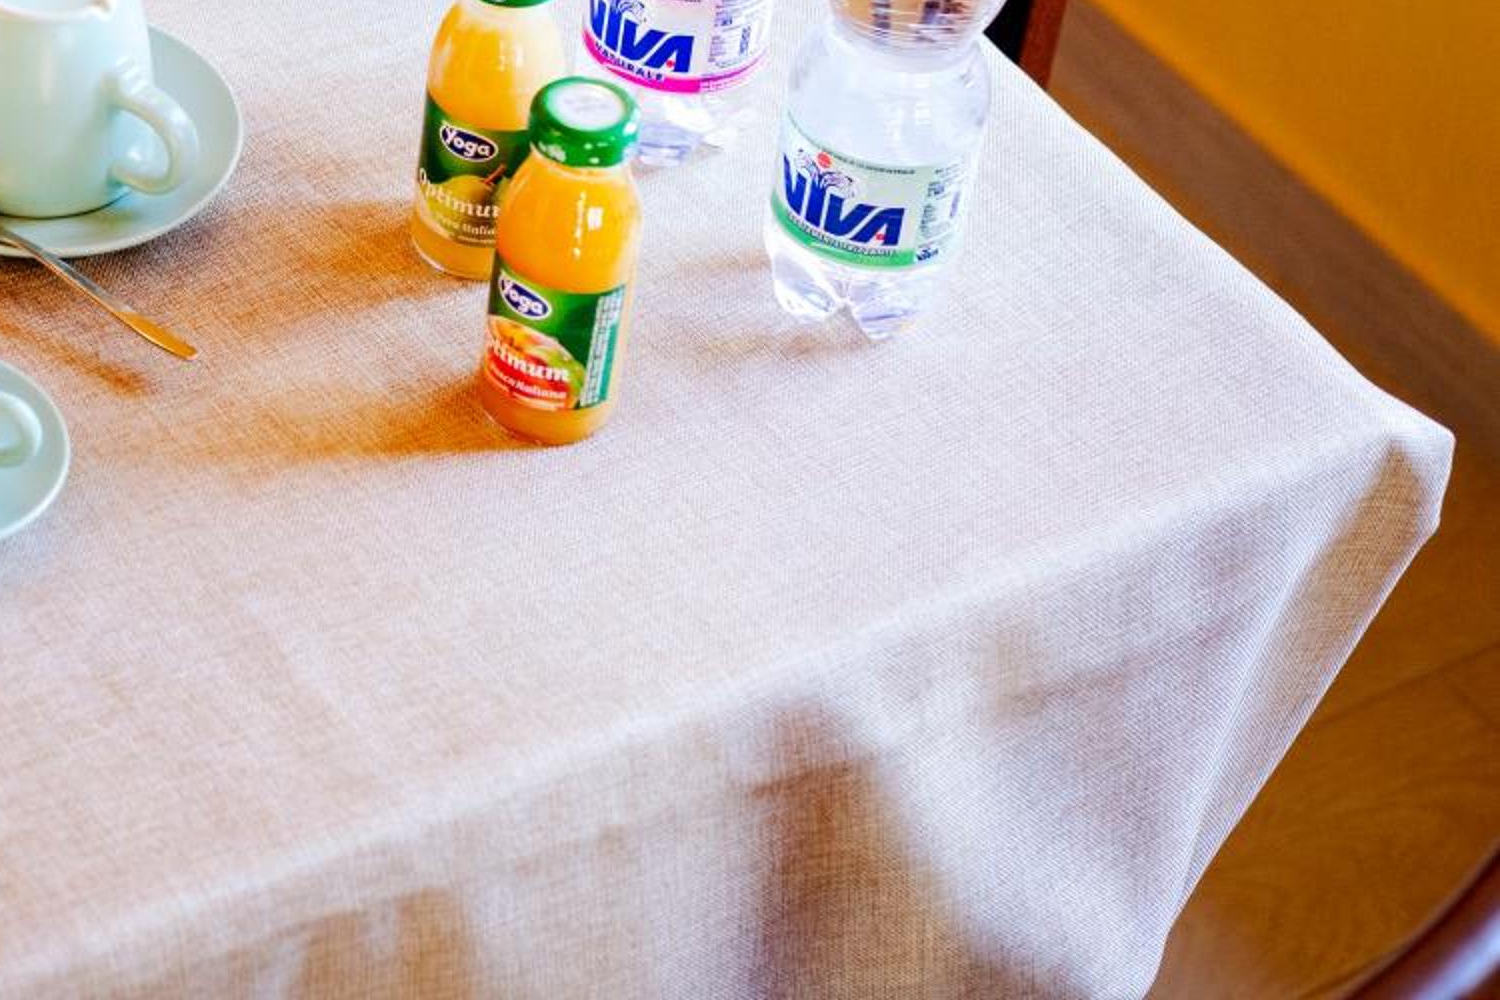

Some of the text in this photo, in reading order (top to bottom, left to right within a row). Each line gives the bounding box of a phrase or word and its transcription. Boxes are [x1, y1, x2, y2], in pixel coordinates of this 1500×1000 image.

[595, 41, 664, 82] NATURALE
[444, 127, 491, 158] Yoga
[783, 152, 906, 247] VIVA
[501, 278, 544, 316] Yoga
[487, 334, 570, 383] ptimum
